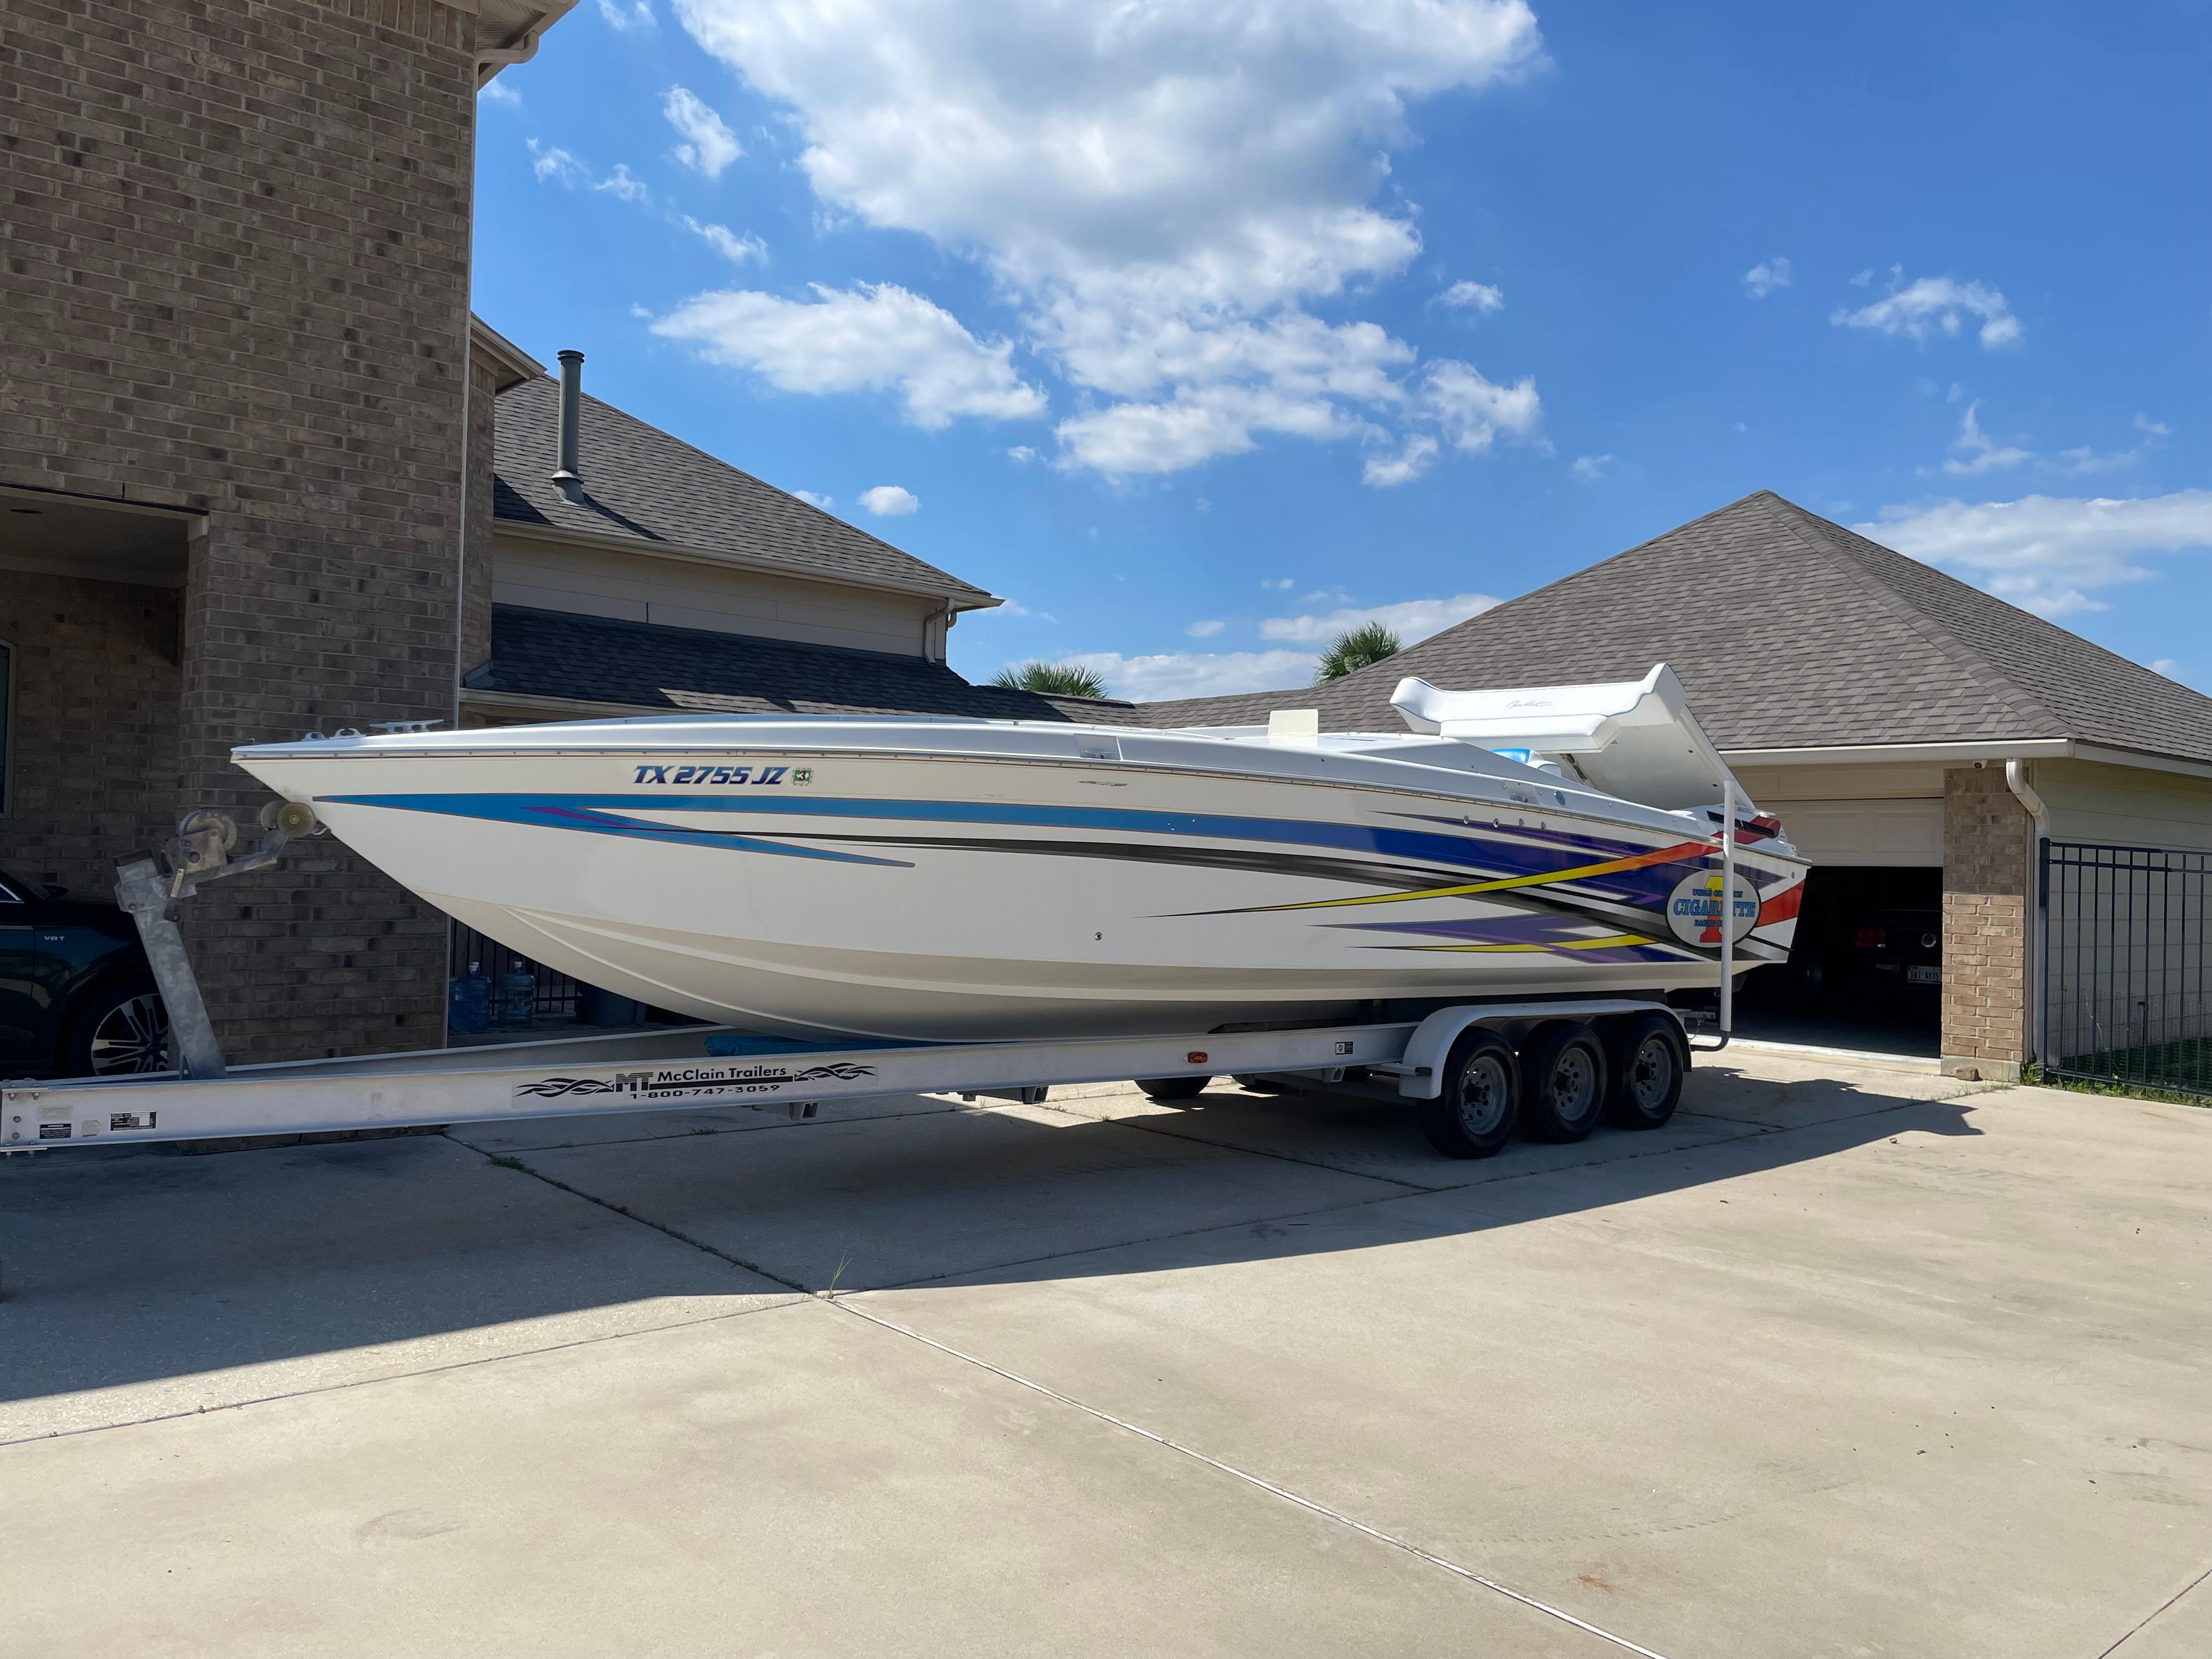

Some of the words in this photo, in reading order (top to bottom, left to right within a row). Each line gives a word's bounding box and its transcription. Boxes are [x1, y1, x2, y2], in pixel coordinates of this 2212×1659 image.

[633, 765, 676, 785] TX
[672, 766, 753, 785] 2755
[751, 766, 791, 785] JZ
[1673, 899, 1756, 917] CIGARTTE
[657, 1068, 725, 1082] McClain
[728, 1065, 787, 1078] Trailers
[630, 1085, 780, 1099] 1-800-747-3059
